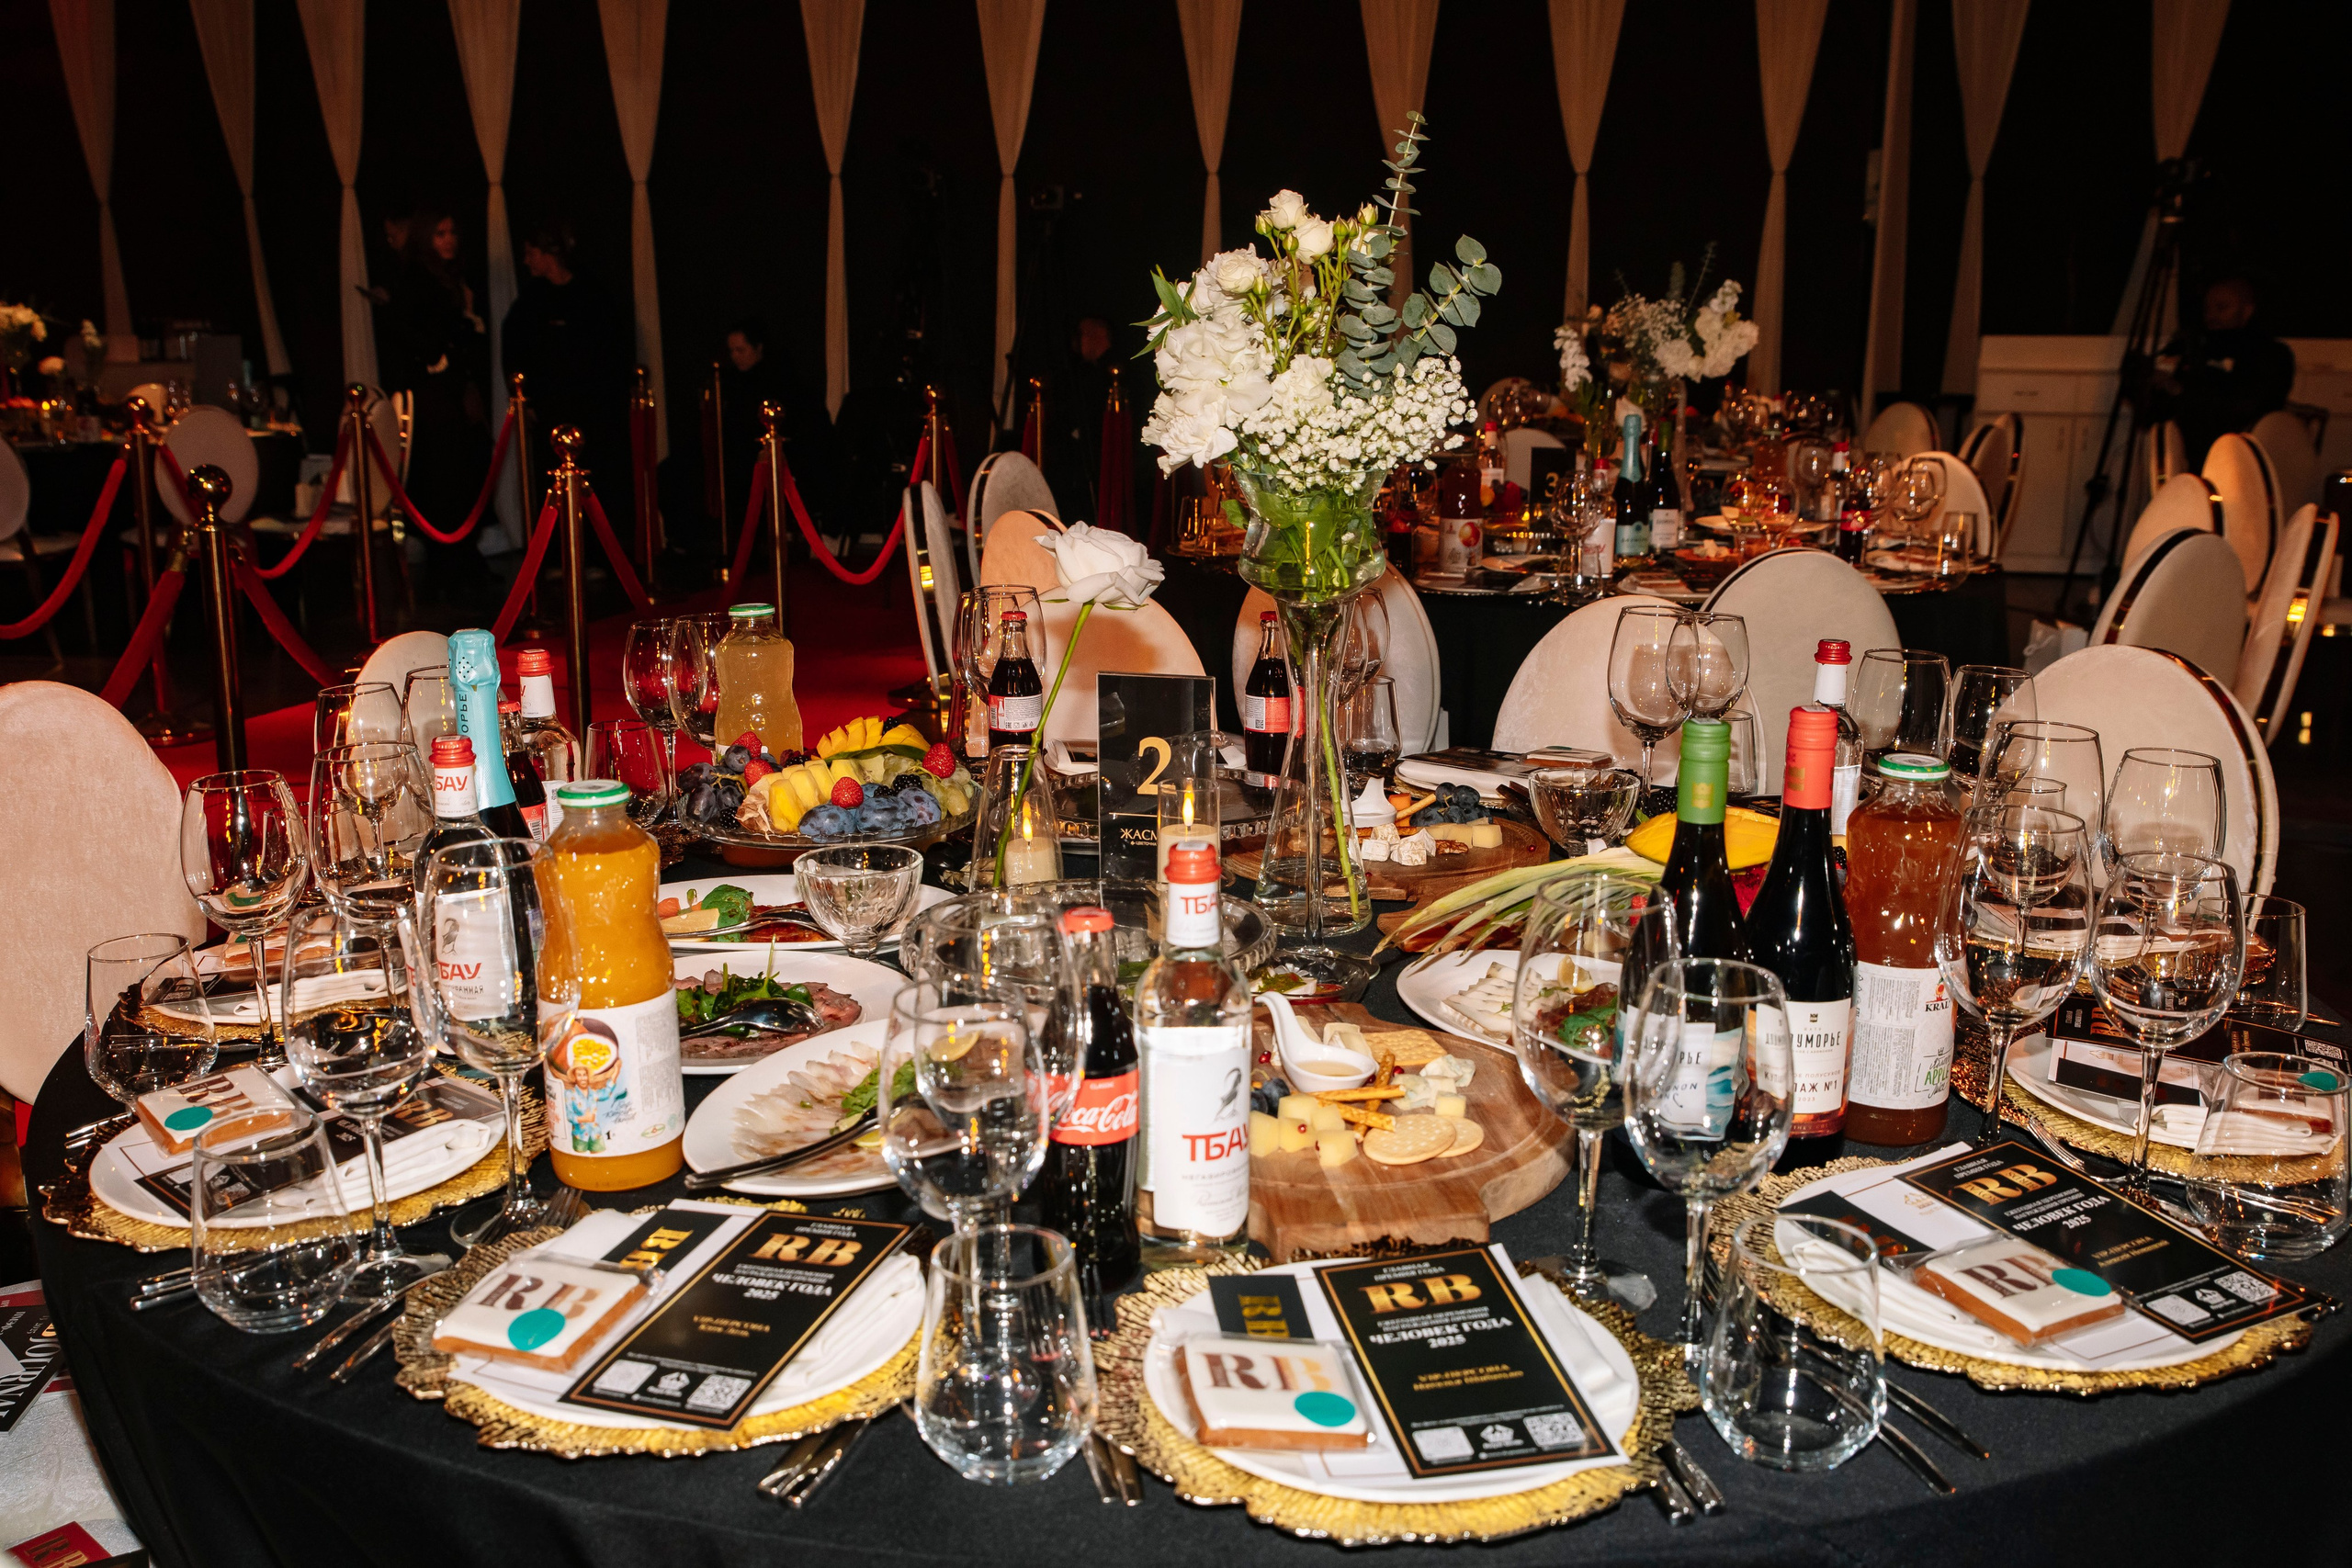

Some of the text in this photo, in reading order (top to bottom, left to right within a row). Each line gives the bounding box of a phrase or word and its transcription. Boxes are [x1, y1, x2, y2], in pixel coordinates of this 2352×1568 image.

[1544, 472, 1559, 497] 3
[1136, 736, 1177, 795] 2
[1925, 1001, 1949, 1012] KRAL
[1791, 1031, 1841, 1048] УМОРЬЕ
[1924, 1067, 1950, 1086] APPLE
[1954, 1164, 2057, 1206] RB
[2012, 1195, 2111, 1232] ЧЕЛОВЕК ГОДА
[2062, 1214, 2092, 1229] 2025
[748, 1233, 863, 1267] RB
[712, 1272, 789, 1292] ЧЕЛОВЕК
[788, 1282, 832, 1296] ГОДА
[1358, 1273, 1482, 1314] RB
[1369, 1316, 1513, 1345] ЧЕЛОВЕК ГОДА
[1427, 1334, 1466, 1348] 2025
[1200, 1352, 1332, 1393] RB
